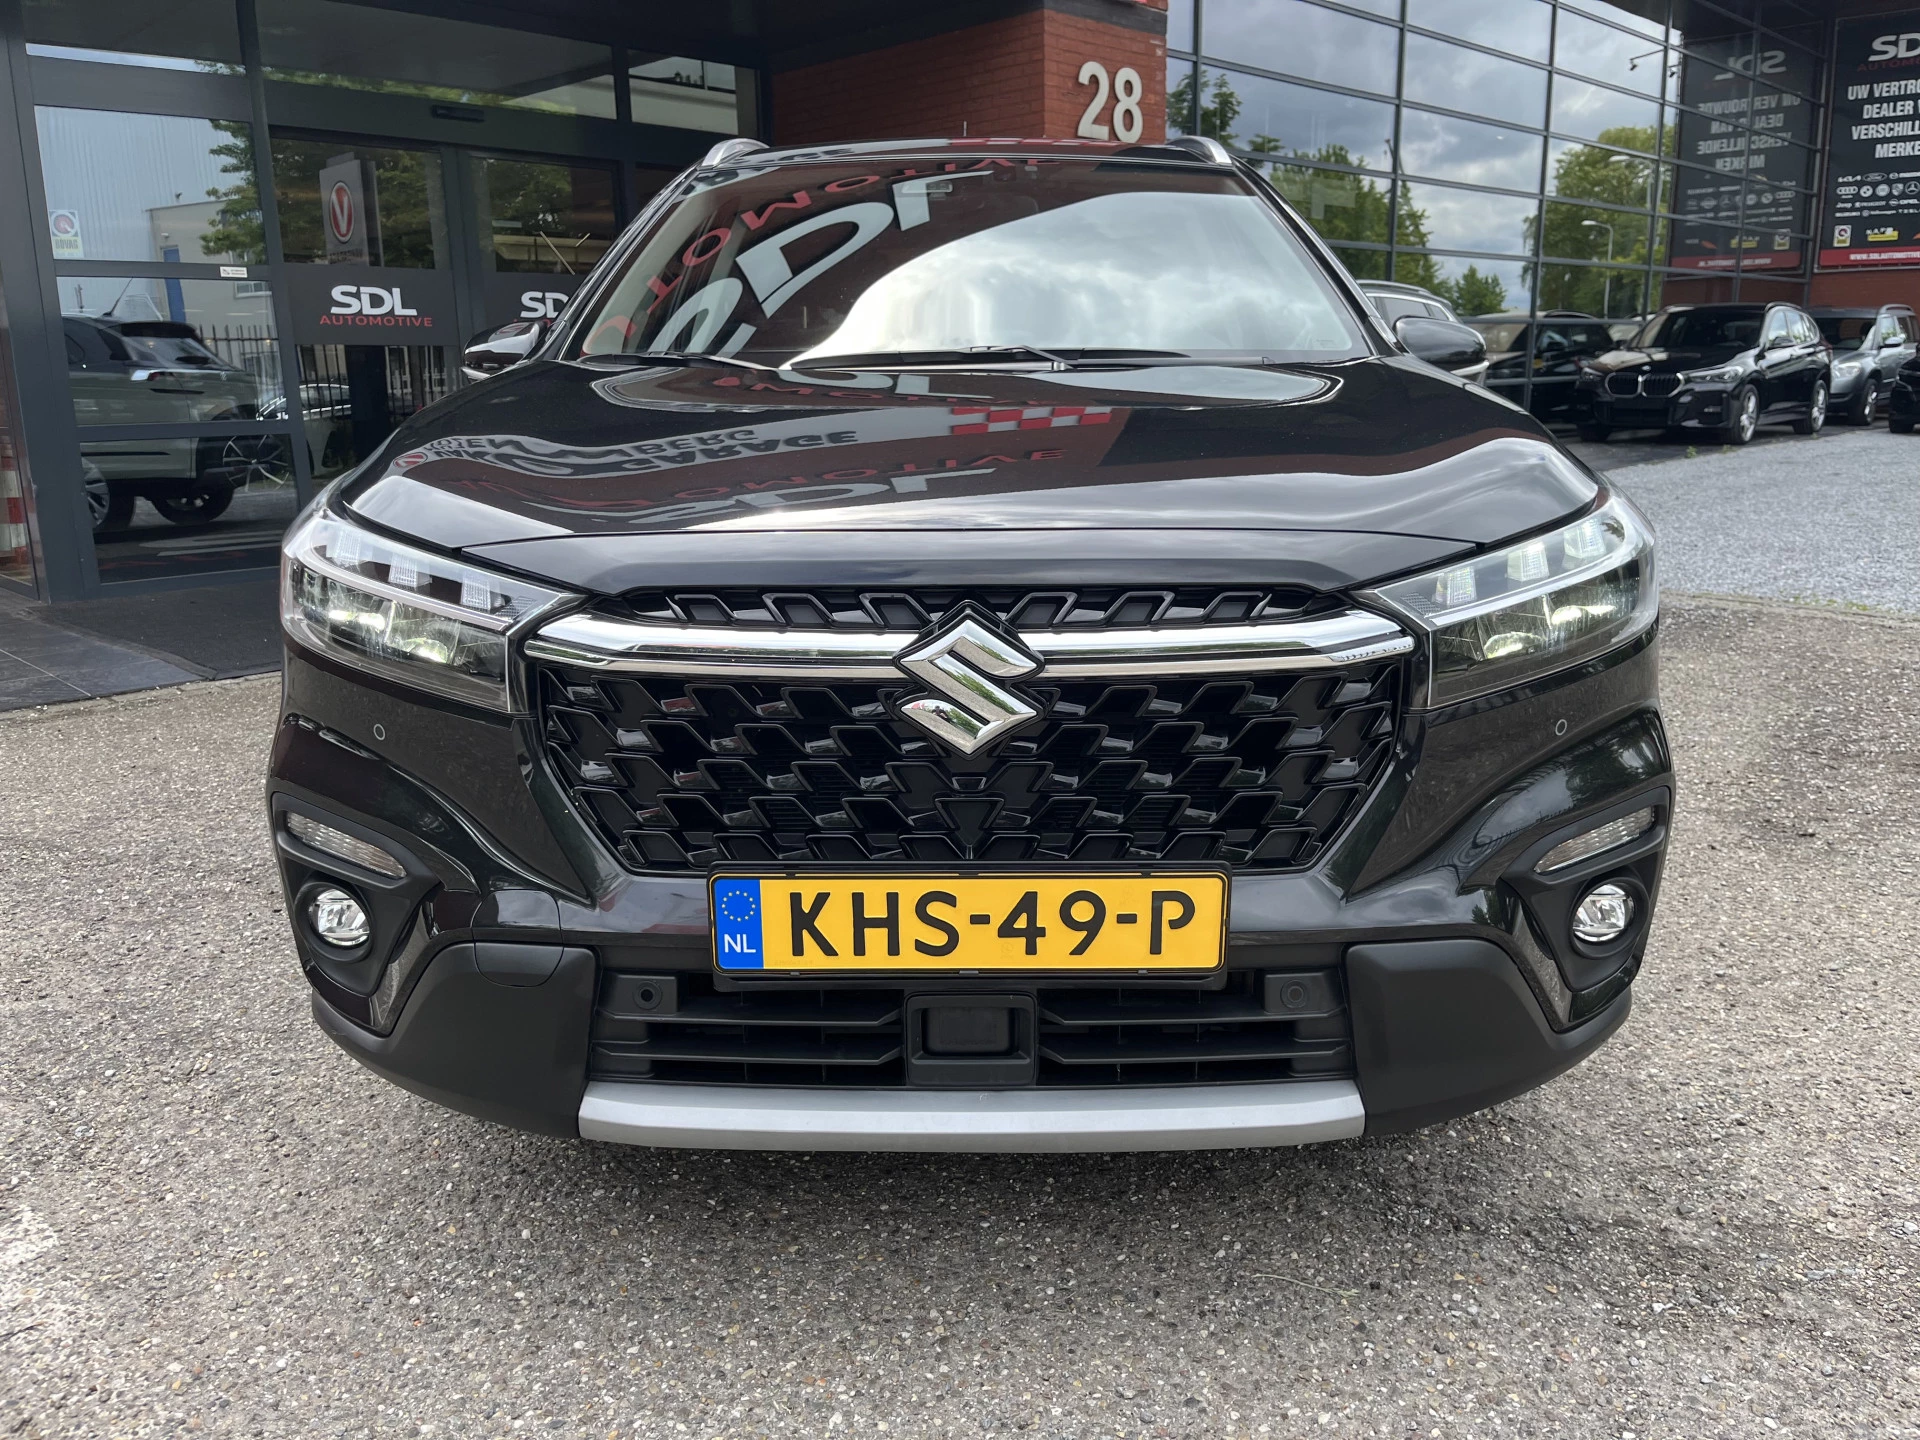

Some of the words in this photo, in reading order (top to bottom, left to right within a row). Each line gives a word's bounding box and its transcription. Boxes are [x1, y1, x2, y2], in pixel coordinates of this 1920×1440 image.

[1077, 61, 1143, 143] 28
[1847, 84, 1870, 100] UW
[1862, 100, 1914, 119] DEALER
[1851, 120, 1920, 140] VERSCHILL
[1875, 140, 1920, 159] MERKE
[330, 284, 417, 316] SDL
[320, 315, 433, 327] AUTOMOTIVE
[789, 889, 1196, 957] KHS-49-P
[723, 934, 757, 954] NL
